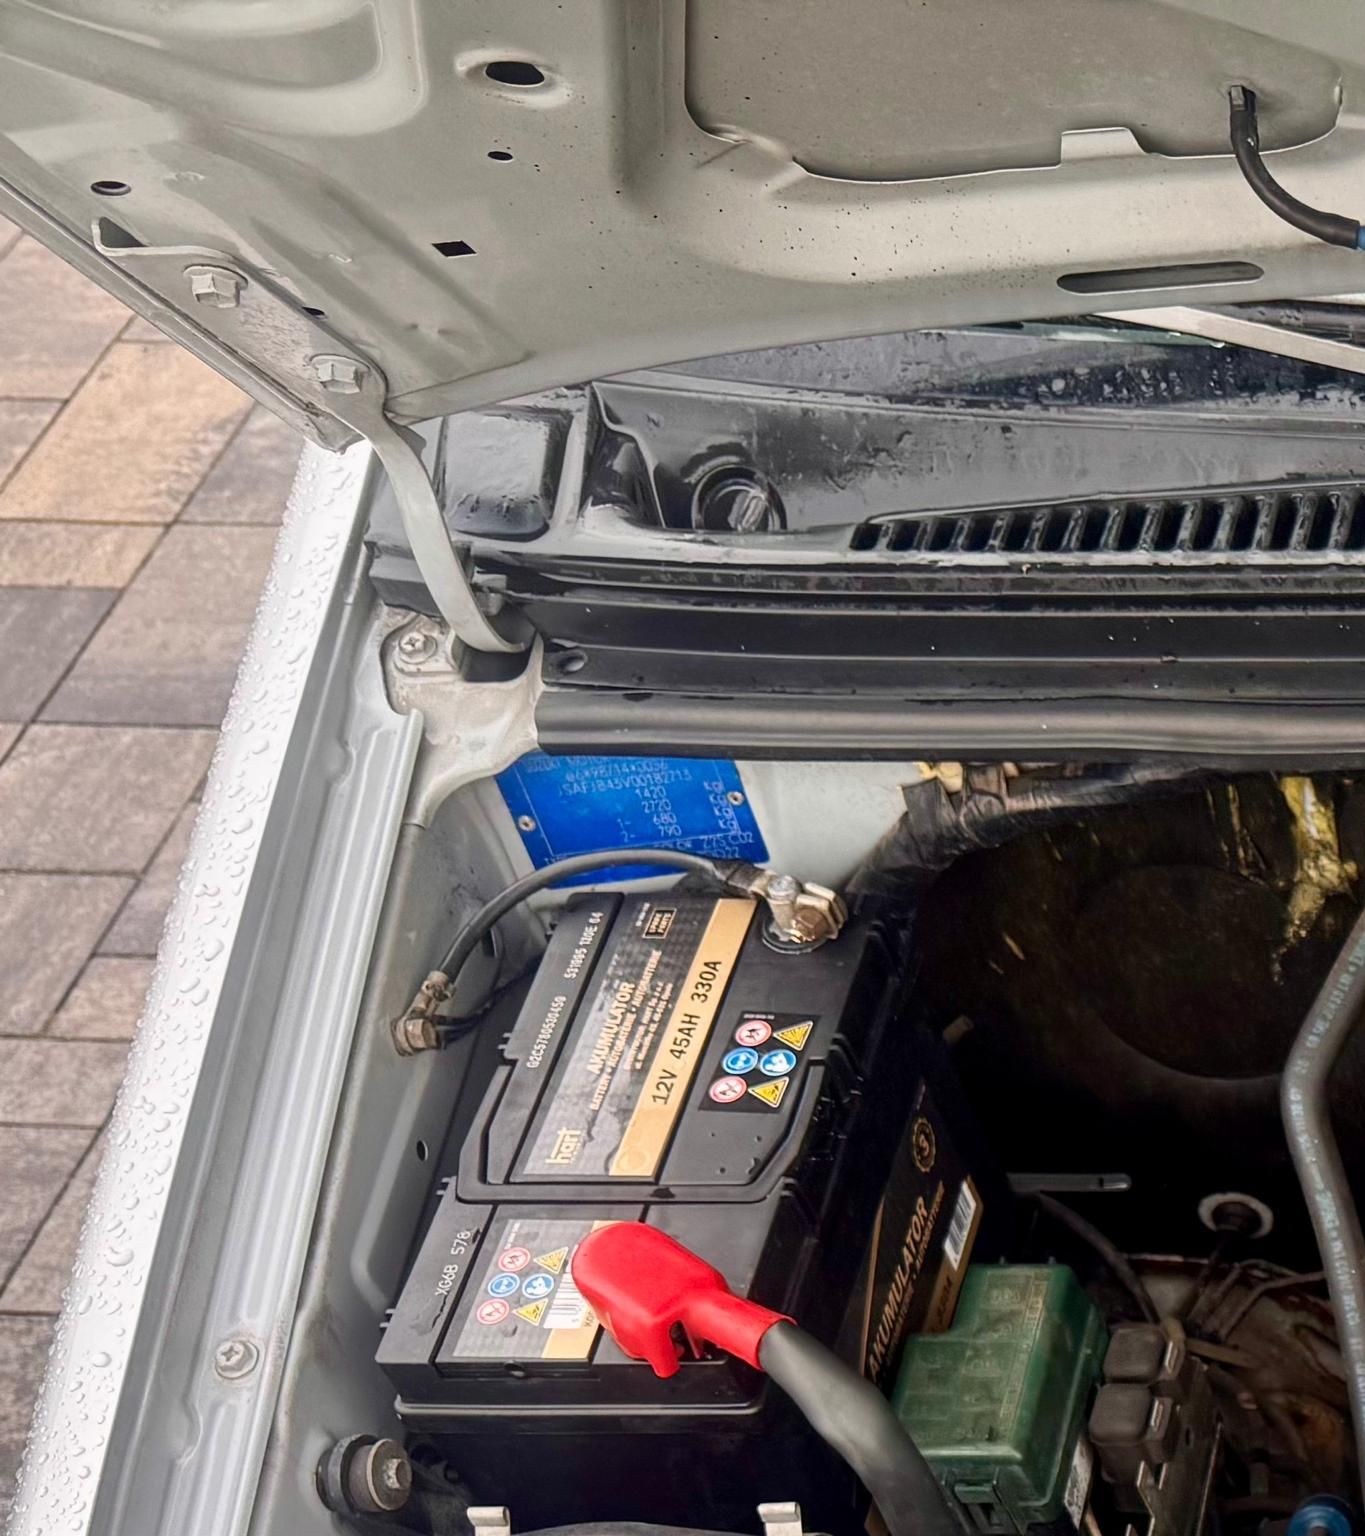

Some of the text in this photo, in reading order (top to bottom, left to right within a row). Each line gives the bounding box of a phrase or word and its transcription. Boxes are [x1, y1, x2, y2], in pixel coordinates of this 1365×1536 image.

[586, 981, 636, 1075] AKUMULATOR
[653, 1067, 678, 1106] 12V
[669, 1012, 701, 1061] 45AH
[692, 960, 723, 1004] 330A
[589, 1070, 613, 1111] BATTERY
[434, 1230, 471, 1297] XG6B 578
[868, 1195, 929, 1380] AKUMULATOR
